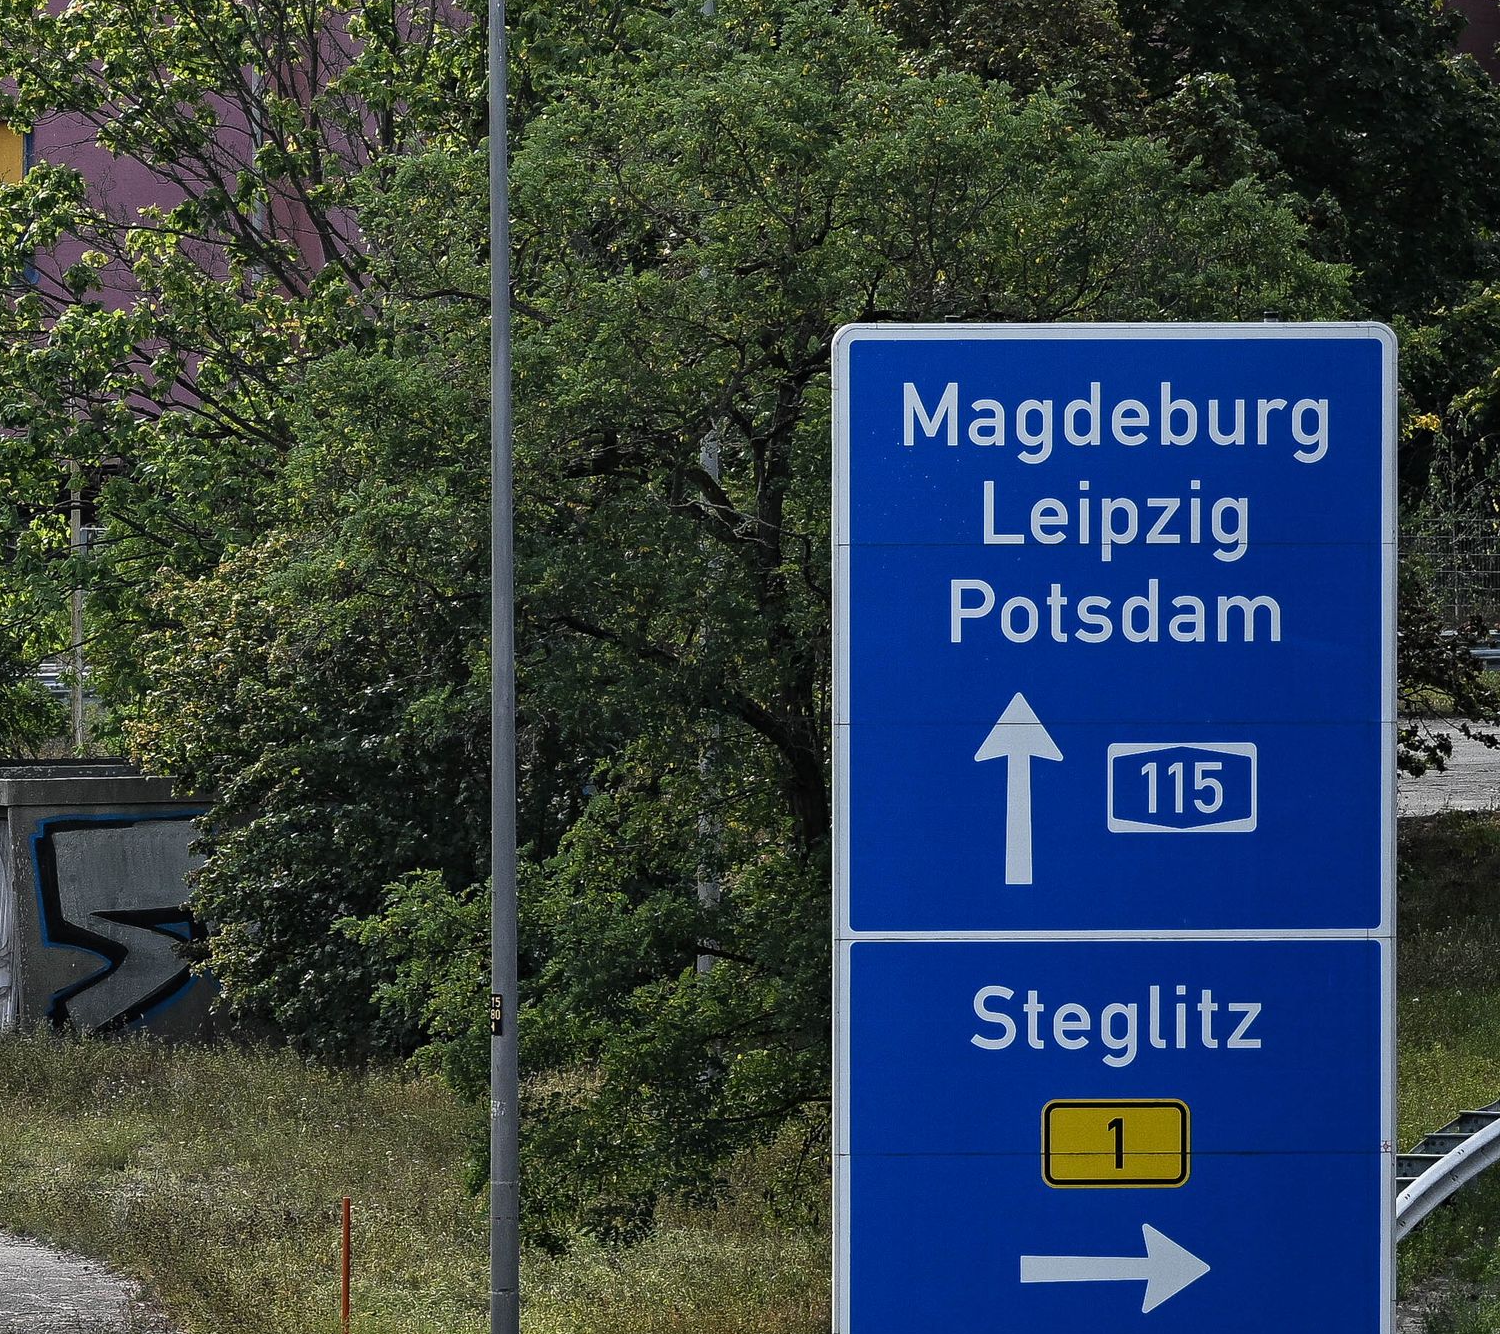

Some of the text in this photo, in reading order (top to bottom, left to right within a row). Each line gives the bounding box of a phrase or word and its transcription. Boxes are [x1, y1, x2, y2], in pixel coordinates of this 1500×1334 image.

[901, 382, 1331, 464] Magdeburg
[983, 481, 1251, 563] Leipzig
[950, 579, 1283, 644] Potsdam
[1140, 759, 1225, 816] 115
[972, 985, 1263, 1069] Steglitz
[1107, 1116, 1127, 1171] 1
